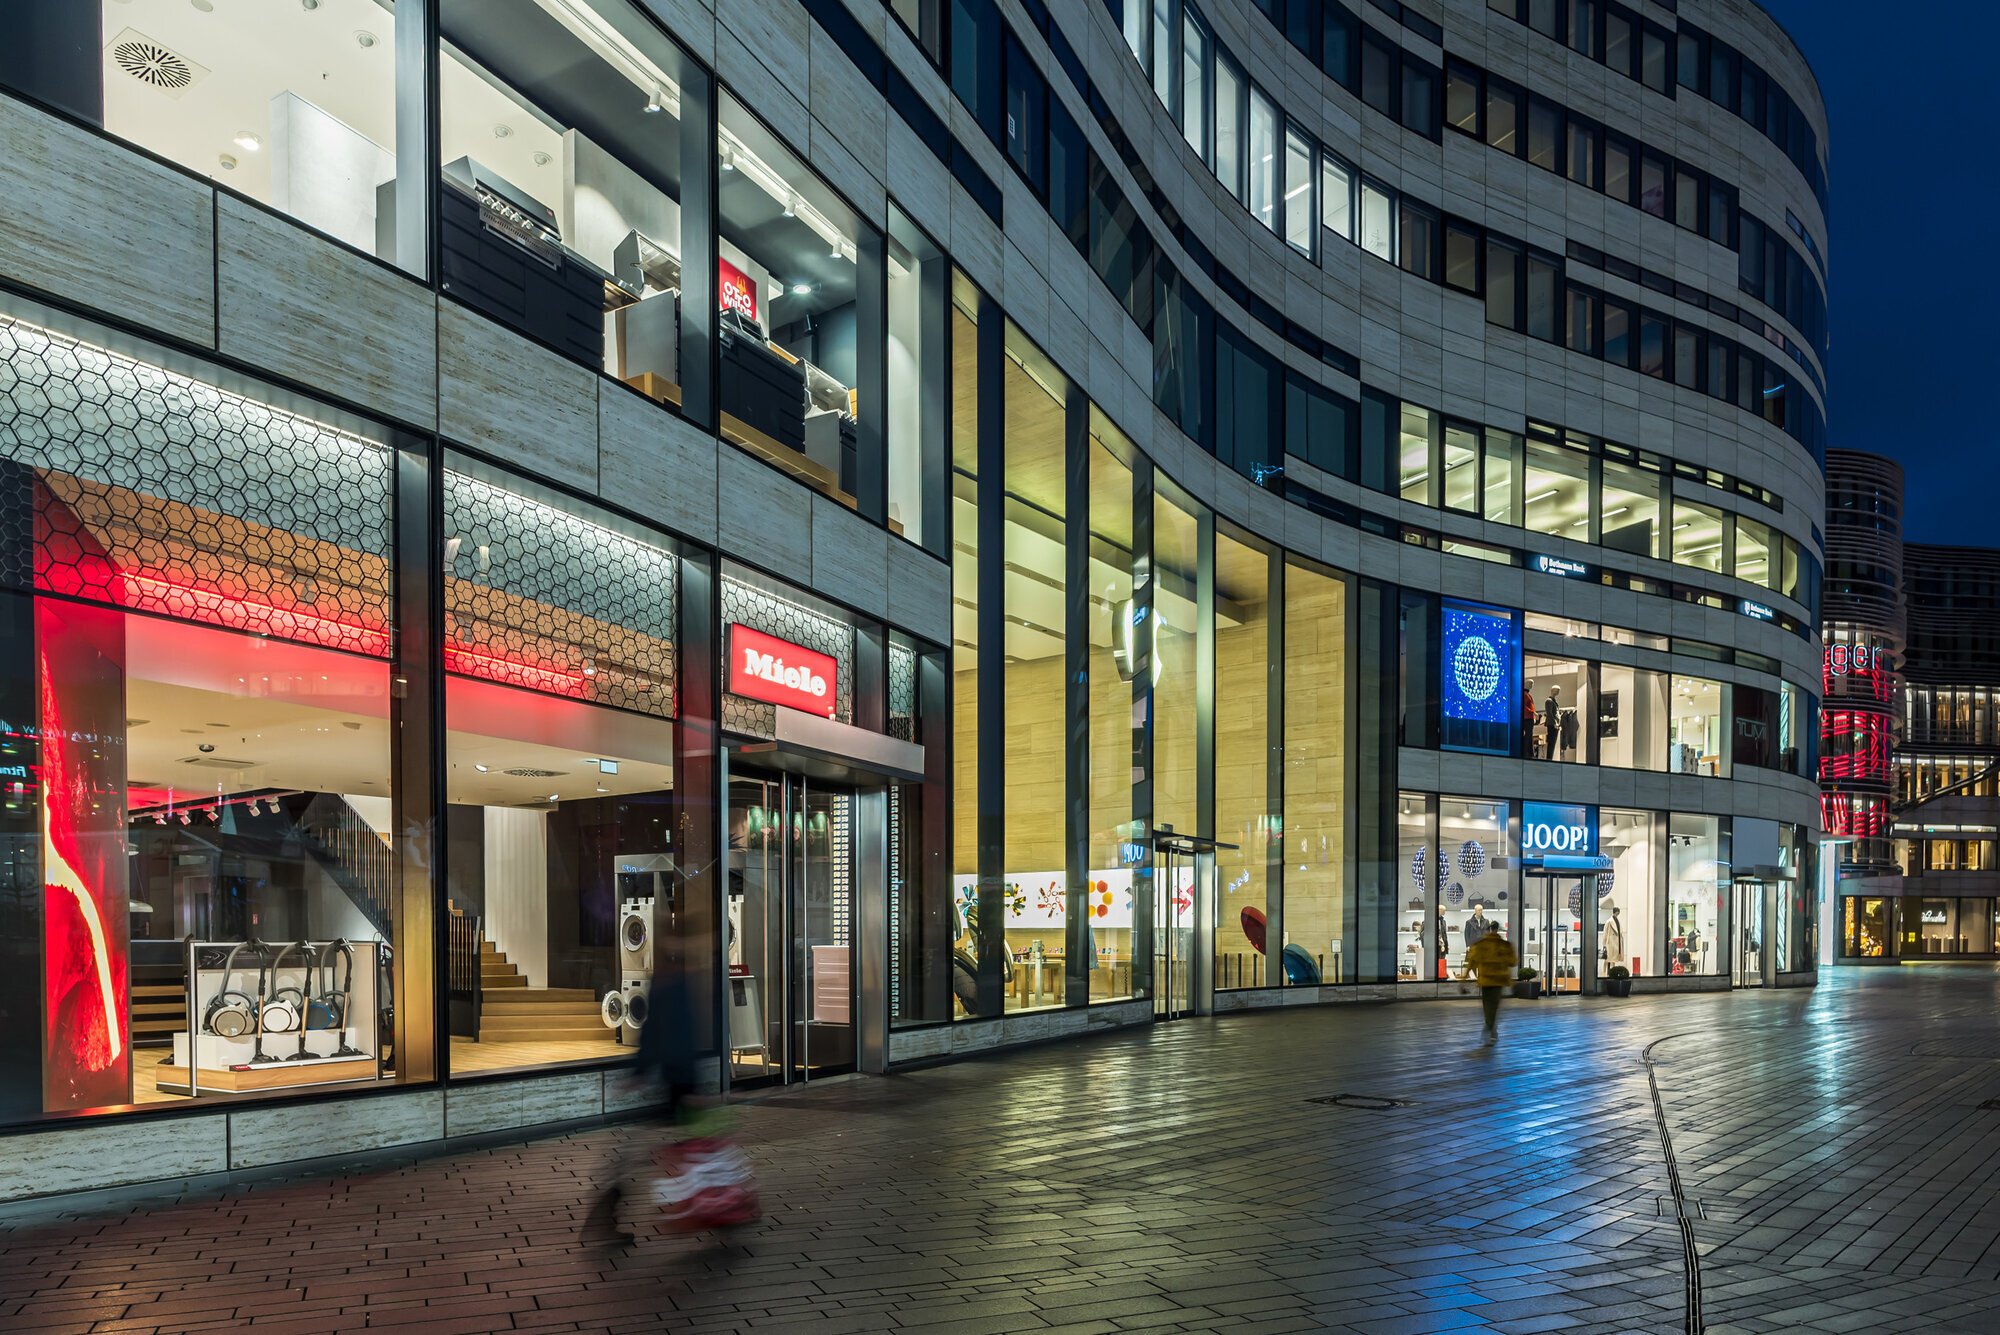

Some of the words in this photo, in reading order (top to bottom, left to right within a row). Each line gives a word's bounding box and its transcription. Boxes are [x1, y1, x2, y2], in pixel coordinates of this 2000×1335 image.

[724, 281, 751, 308] OTTO
[744, 648, 827, 697] Miele
[1830, 643, 1883, 676] ger
[1736, 716, 1766, 740] TUMI
[1522, 823, 1589, 852] JOOP!
